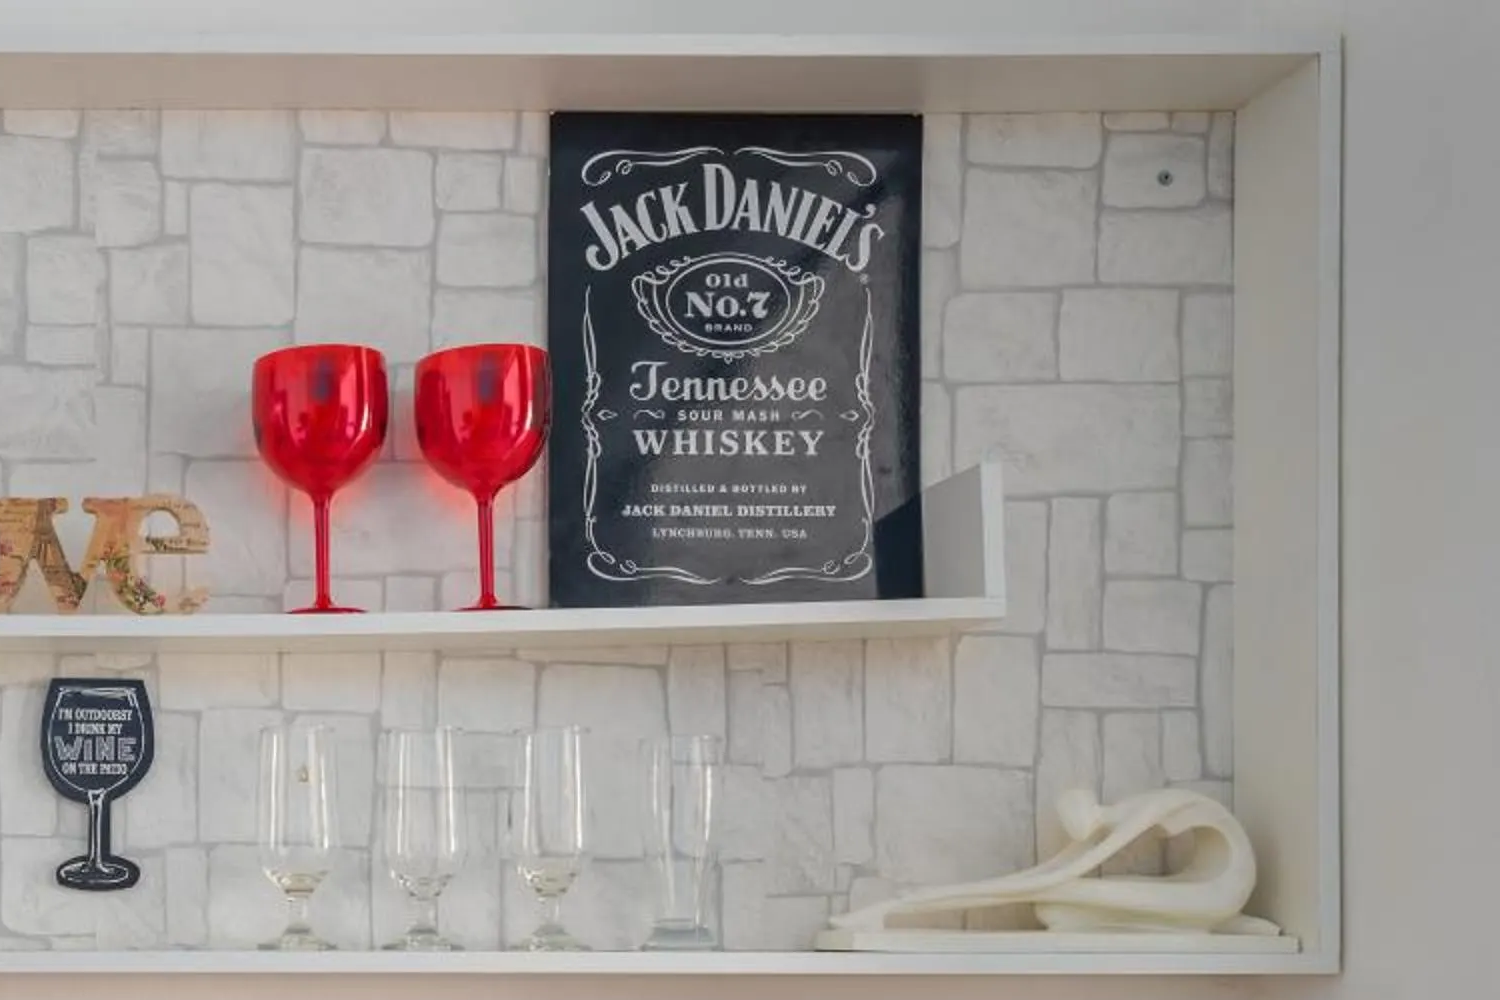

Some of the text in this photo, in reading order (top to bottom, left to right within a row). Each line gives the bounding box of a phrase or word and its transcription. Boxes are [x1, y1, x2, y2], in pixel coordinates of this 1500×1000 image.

[580, 162, 885, 271] JACK DANIEL'S
[705, 273, 749, 288] Old
[704, 323, 754, 334] BRAND
[629, 361, 828, 402] Tennessee
[676, 409, 781, 422] SOUR MASH
[632, 429, 824, 456] WHISKEY
[651, 483, 715, 494] DISTILLED
[731, 484, 788, 494] BOTTLED
[791, 484, 808, 494] BY
[621, 504, 837, 518] JACK DANIEL DISTILLERY
[74, 707, 133, 721] OUTDOORSY
[74, 722, 106, 735] DRINK
[107, 723, 123, 735] MY
[53, 735, 137, 762] WINE
[61, 762, 128, 776] ON THE PATIO
